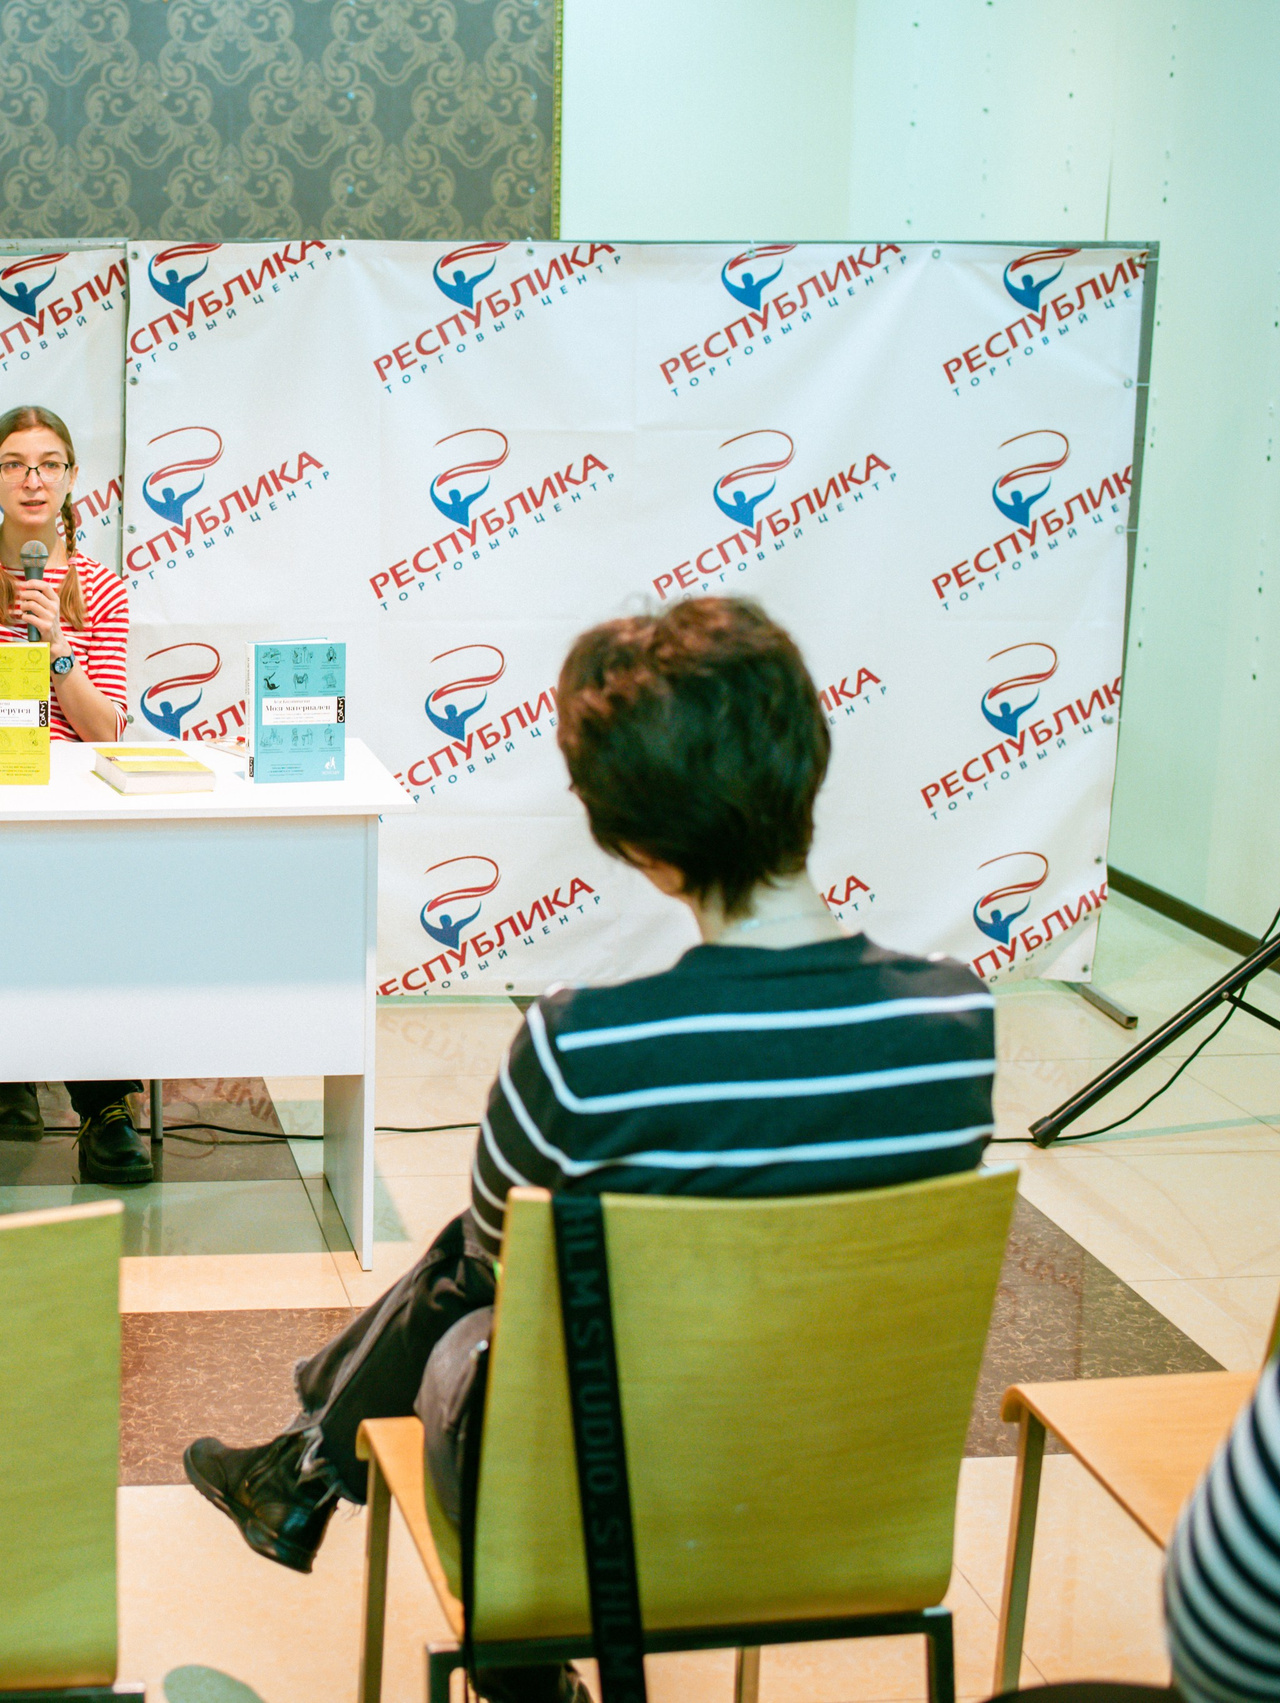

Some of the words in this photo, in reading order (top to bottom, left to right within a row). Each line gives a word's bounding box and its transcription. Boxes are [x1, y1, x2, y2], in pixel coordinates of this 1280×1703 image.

[126, 240, 326, 364] СПУБЛИКА
[135, 306, 236, 373] РГОВЫЙ
[253, 250, 333, 306] ЦЕНТР
[373, 243, 616, 382] РЕСПУБЛИКА
[384, 308, 525, 394] ТОРГОВЫЙ
[540, 254, 621, 306] ЦЕНТР
[659, 243, 902, 385] РЕСПУБЛИКА
[670, 310, 812, 397] ТОРГОВЫЙ
[827, 254, 908, 308] ЦЕНТР
[952, 312, 1089, 397] ТОРГОВЫЙ
[122, 451, 324, 581] СПУБЛИКА
[131, 525, 235, 590] РГОВЫЙ
[250, 469, 331, 523] ЦЕНТР
[369, 453, 609, 600] РЕСПУБЛИКА
[380, 526, 519, 611] ТОРГОВЫЙ
[534, 473, 615, 525] ЦЕНТР
[652, 453, 891, 601] РЕСПУБЛИКА
[817, 471, 898, 525] ЦЕНТР
[931, 464, 1133, 600] РЕСПУБЛИК
[941, 526, 1078, 611] ТОРГОВЫЙ
[394, 686, 558, 793] СПУБЛИ
[920, 676, 1121, 809] РЕСПУБЛИК
[931, 737, 1067, 821] ТОРГОВЫЙ
[376, 877, 596, 996] ЕСПУБЛИКА
[523, 894, 602, 946] ЦЕНТР
